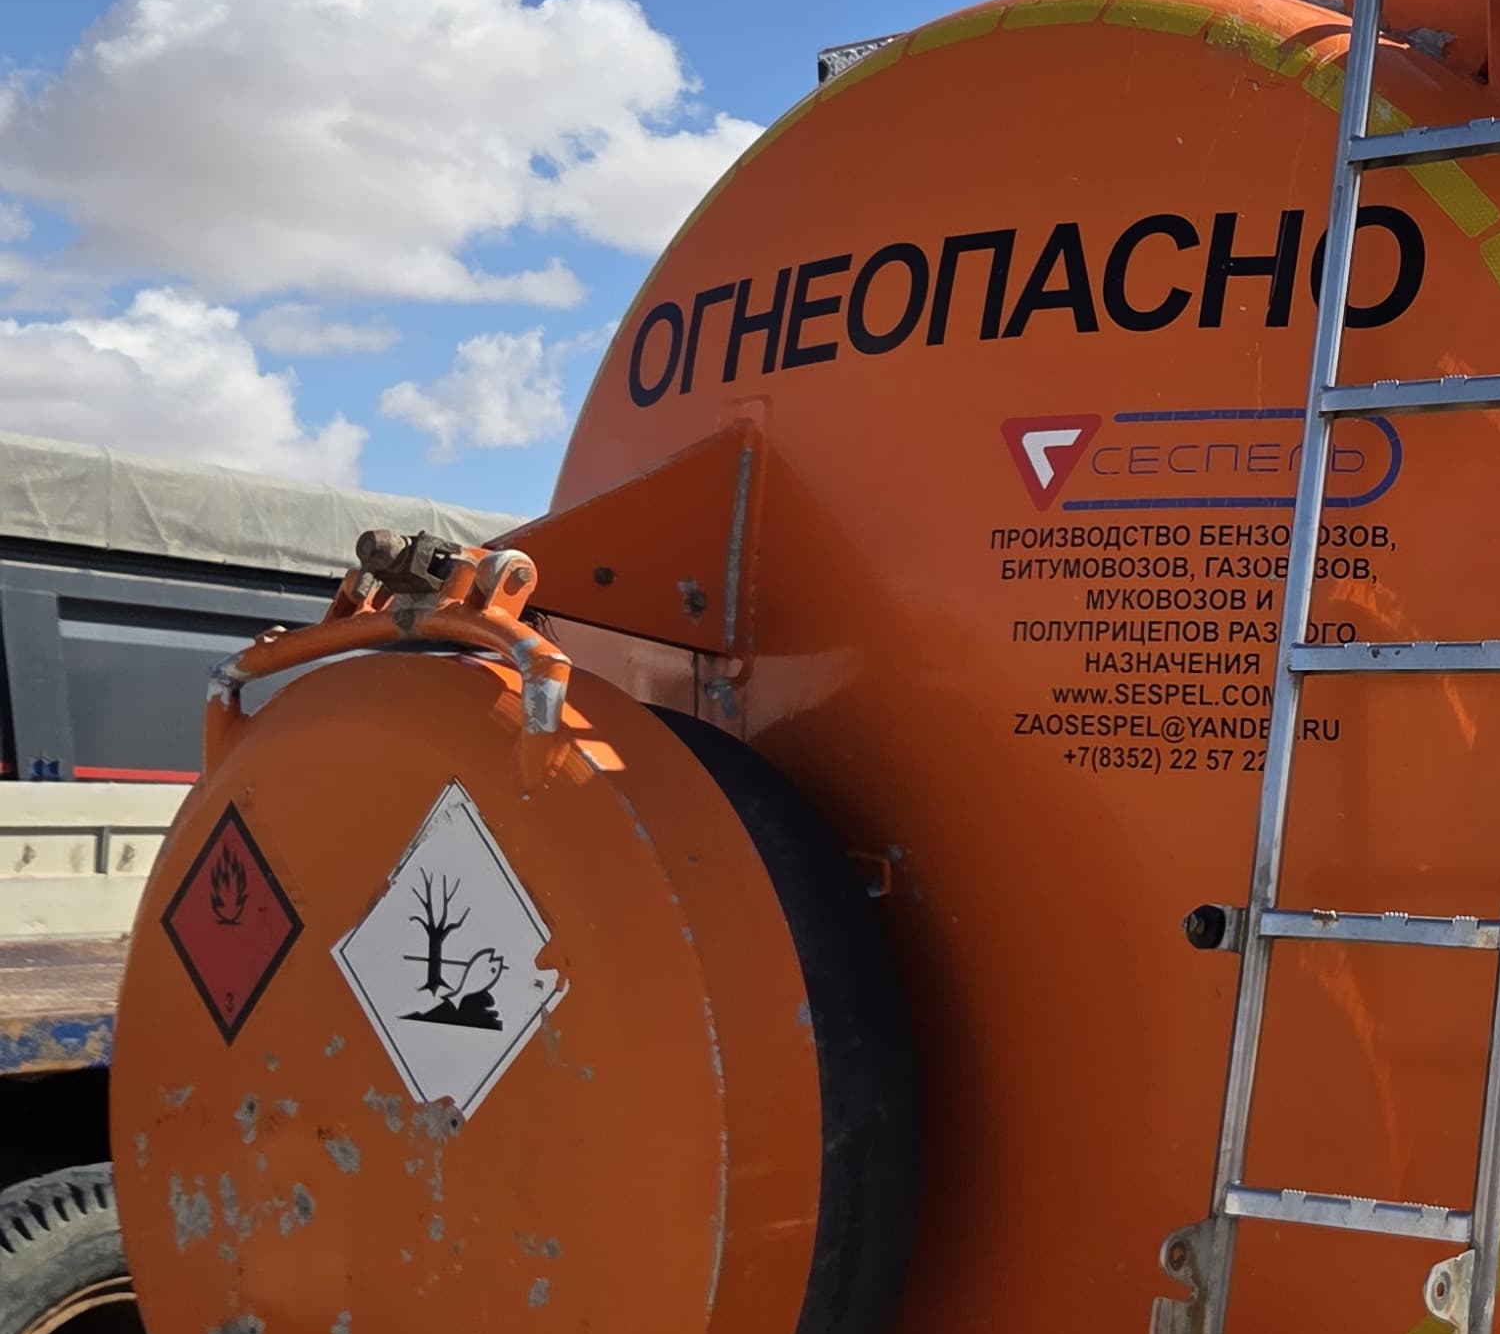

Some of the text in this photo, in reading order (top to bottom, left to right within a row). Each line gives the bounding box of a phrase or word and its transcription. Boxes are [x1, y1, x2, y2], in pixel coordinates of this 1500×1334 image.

[628, 205, 1425, 408] ОГНЕОПАСНО
[990, 524, 1397, 551] ПРОИЗВОДСТВО БЕНЗООЗОВ,
[1001, 556, 1377, 584] БИТУМОВОЗОВ, ГАЗОВЗОВ,
[1086, 589, 1273, 611] МУКОВОЗОВ И
[1012, 621, 1356, 646] ПОЛУПРИЦЕПОВ РАЗОГО
[1085, 652, 1261, 675] НАЗНАЧЕНИЯ
[1014, 713, 1341, 744] ZAOSESPEL@YANDE.RU
[1063, 746, 1162, 775] +7(8352)
[1169, 748, 1197, 770] 22
[1206, 749, 1234, 771] 57
[225, 992, 234, 1013] 3
